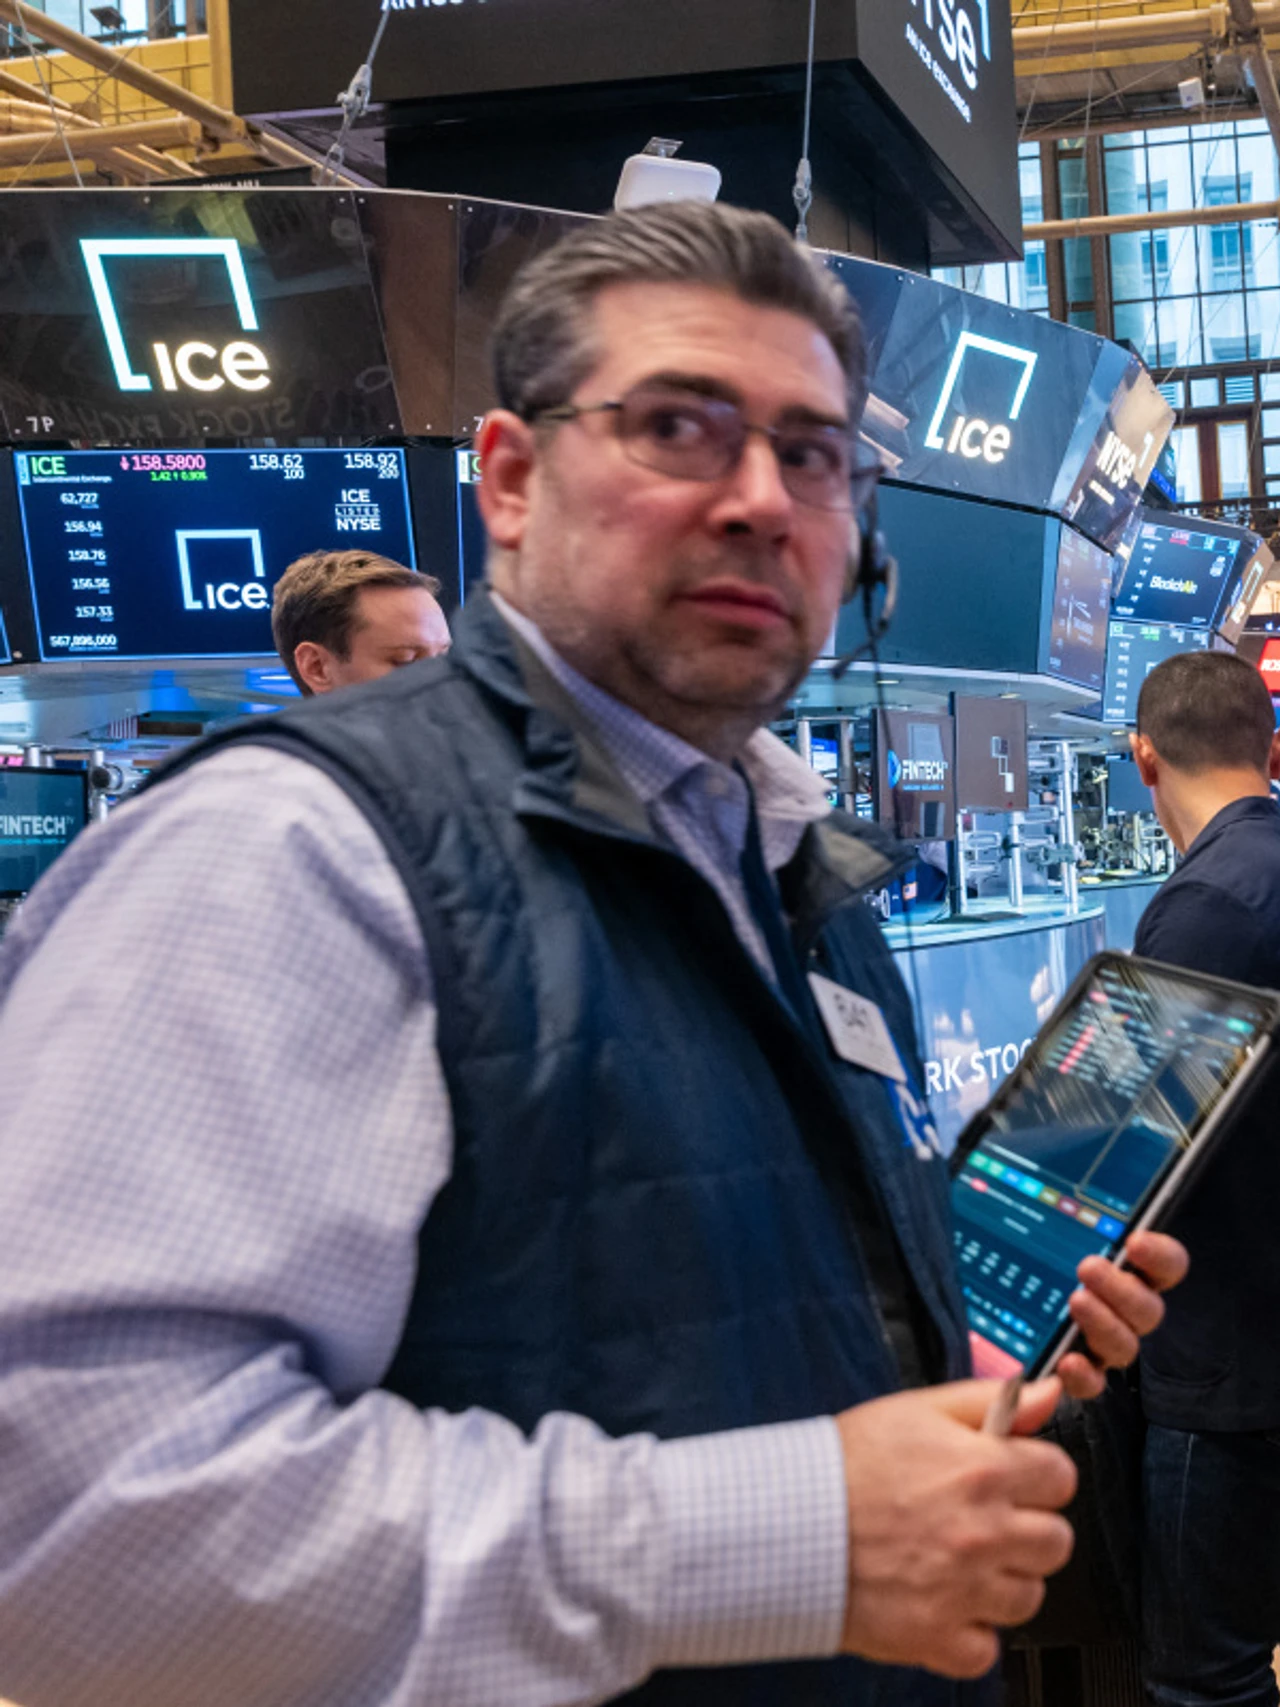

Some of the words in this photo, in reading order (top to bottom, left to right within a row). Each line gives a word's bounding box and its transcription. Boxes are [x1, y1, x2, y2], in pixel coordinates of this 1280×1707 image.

[31, 456, 67, 475] ICE
[132, 455, 206, 471] 158.5800
[249, 455, 304, 470] 158.62
[344, 453, 398, 469] 158.92
[284, 469, 305, 479] 100
[341, 489, 371, 502] ICE
[336, 518, 382, 530] NYSE
[902, 760, 944, 780] FINTECH
